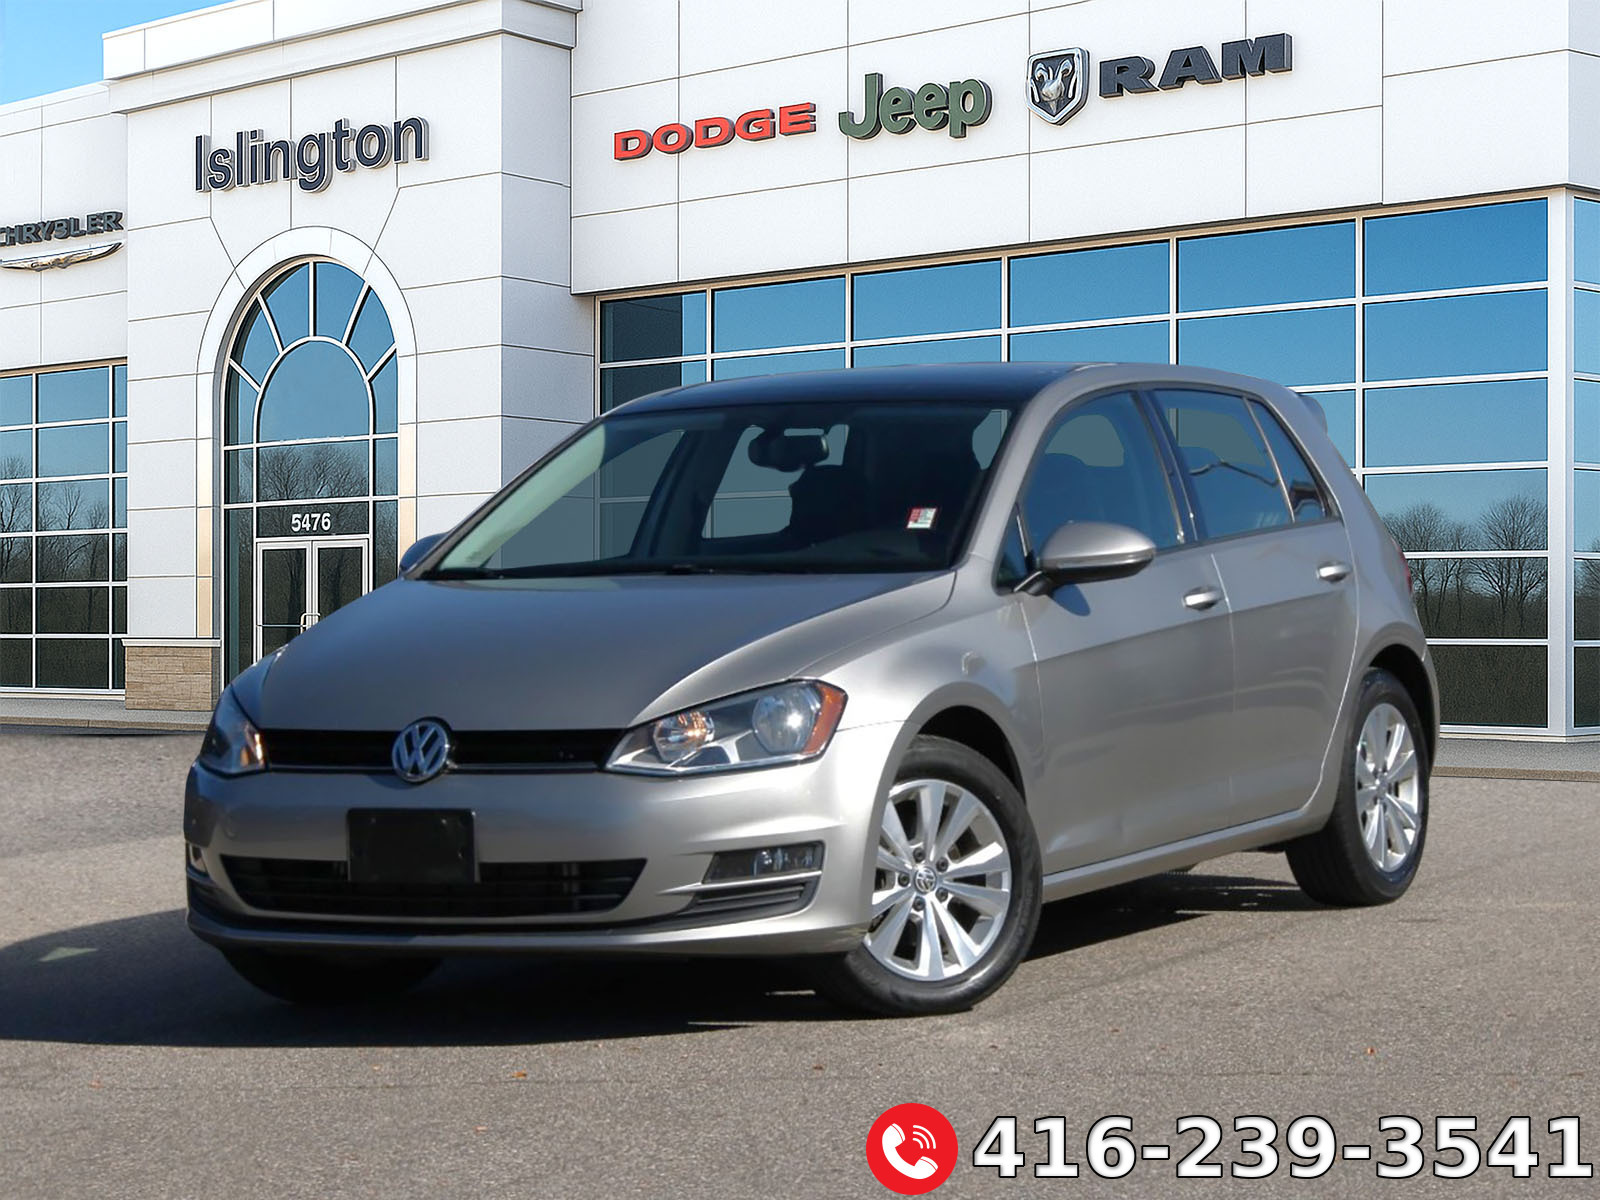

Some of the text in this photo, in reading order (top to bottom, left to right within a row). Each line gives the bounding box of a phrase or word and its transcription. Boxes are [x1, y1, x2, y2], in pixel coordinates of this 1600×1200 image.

[1100, 33, 1293, 98] RAM
[613, 101, 817, 161] DODGE
[839, 73, 991, 140] Jeep
[195, 115, 429, 191] Islington
[291, 512, 331, 532] 5476
